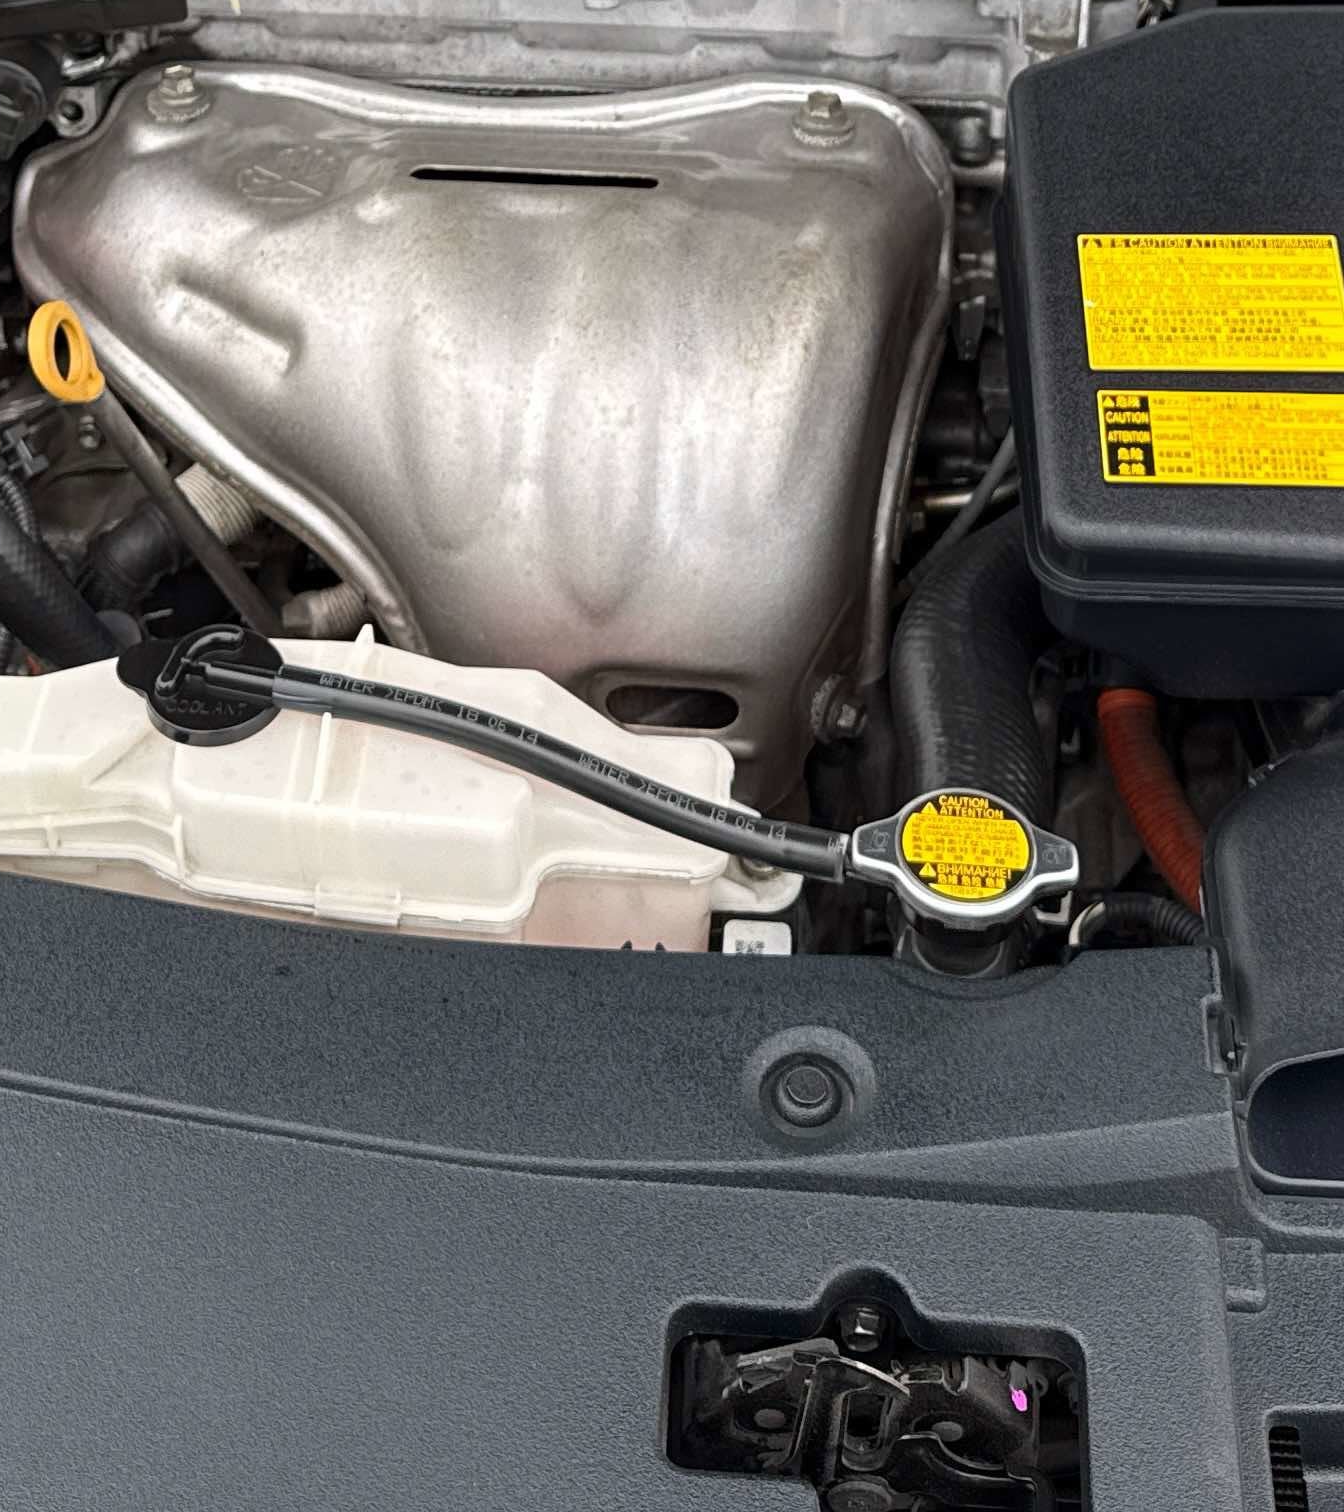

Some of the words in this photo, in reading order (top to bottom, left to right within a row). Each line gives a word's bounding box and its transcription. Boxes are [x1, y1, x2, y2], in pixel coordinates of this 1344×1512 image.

[1105, 410, 1149, 425] CAUTION
[1108, 430, 1151, 444] ATTENTION
[319, 672, 375, 695] WATER
[165, 699, 248, 717] COOLANT
[578, 752, 630, 785] WATER
[767, 825, 787, 842] 14
[938, 794, 989, 809] CAUTION
[939, 805, 1004, 819] ATTENTION
[937, 864, 1012, 880] ВНИМАНИЕ!
